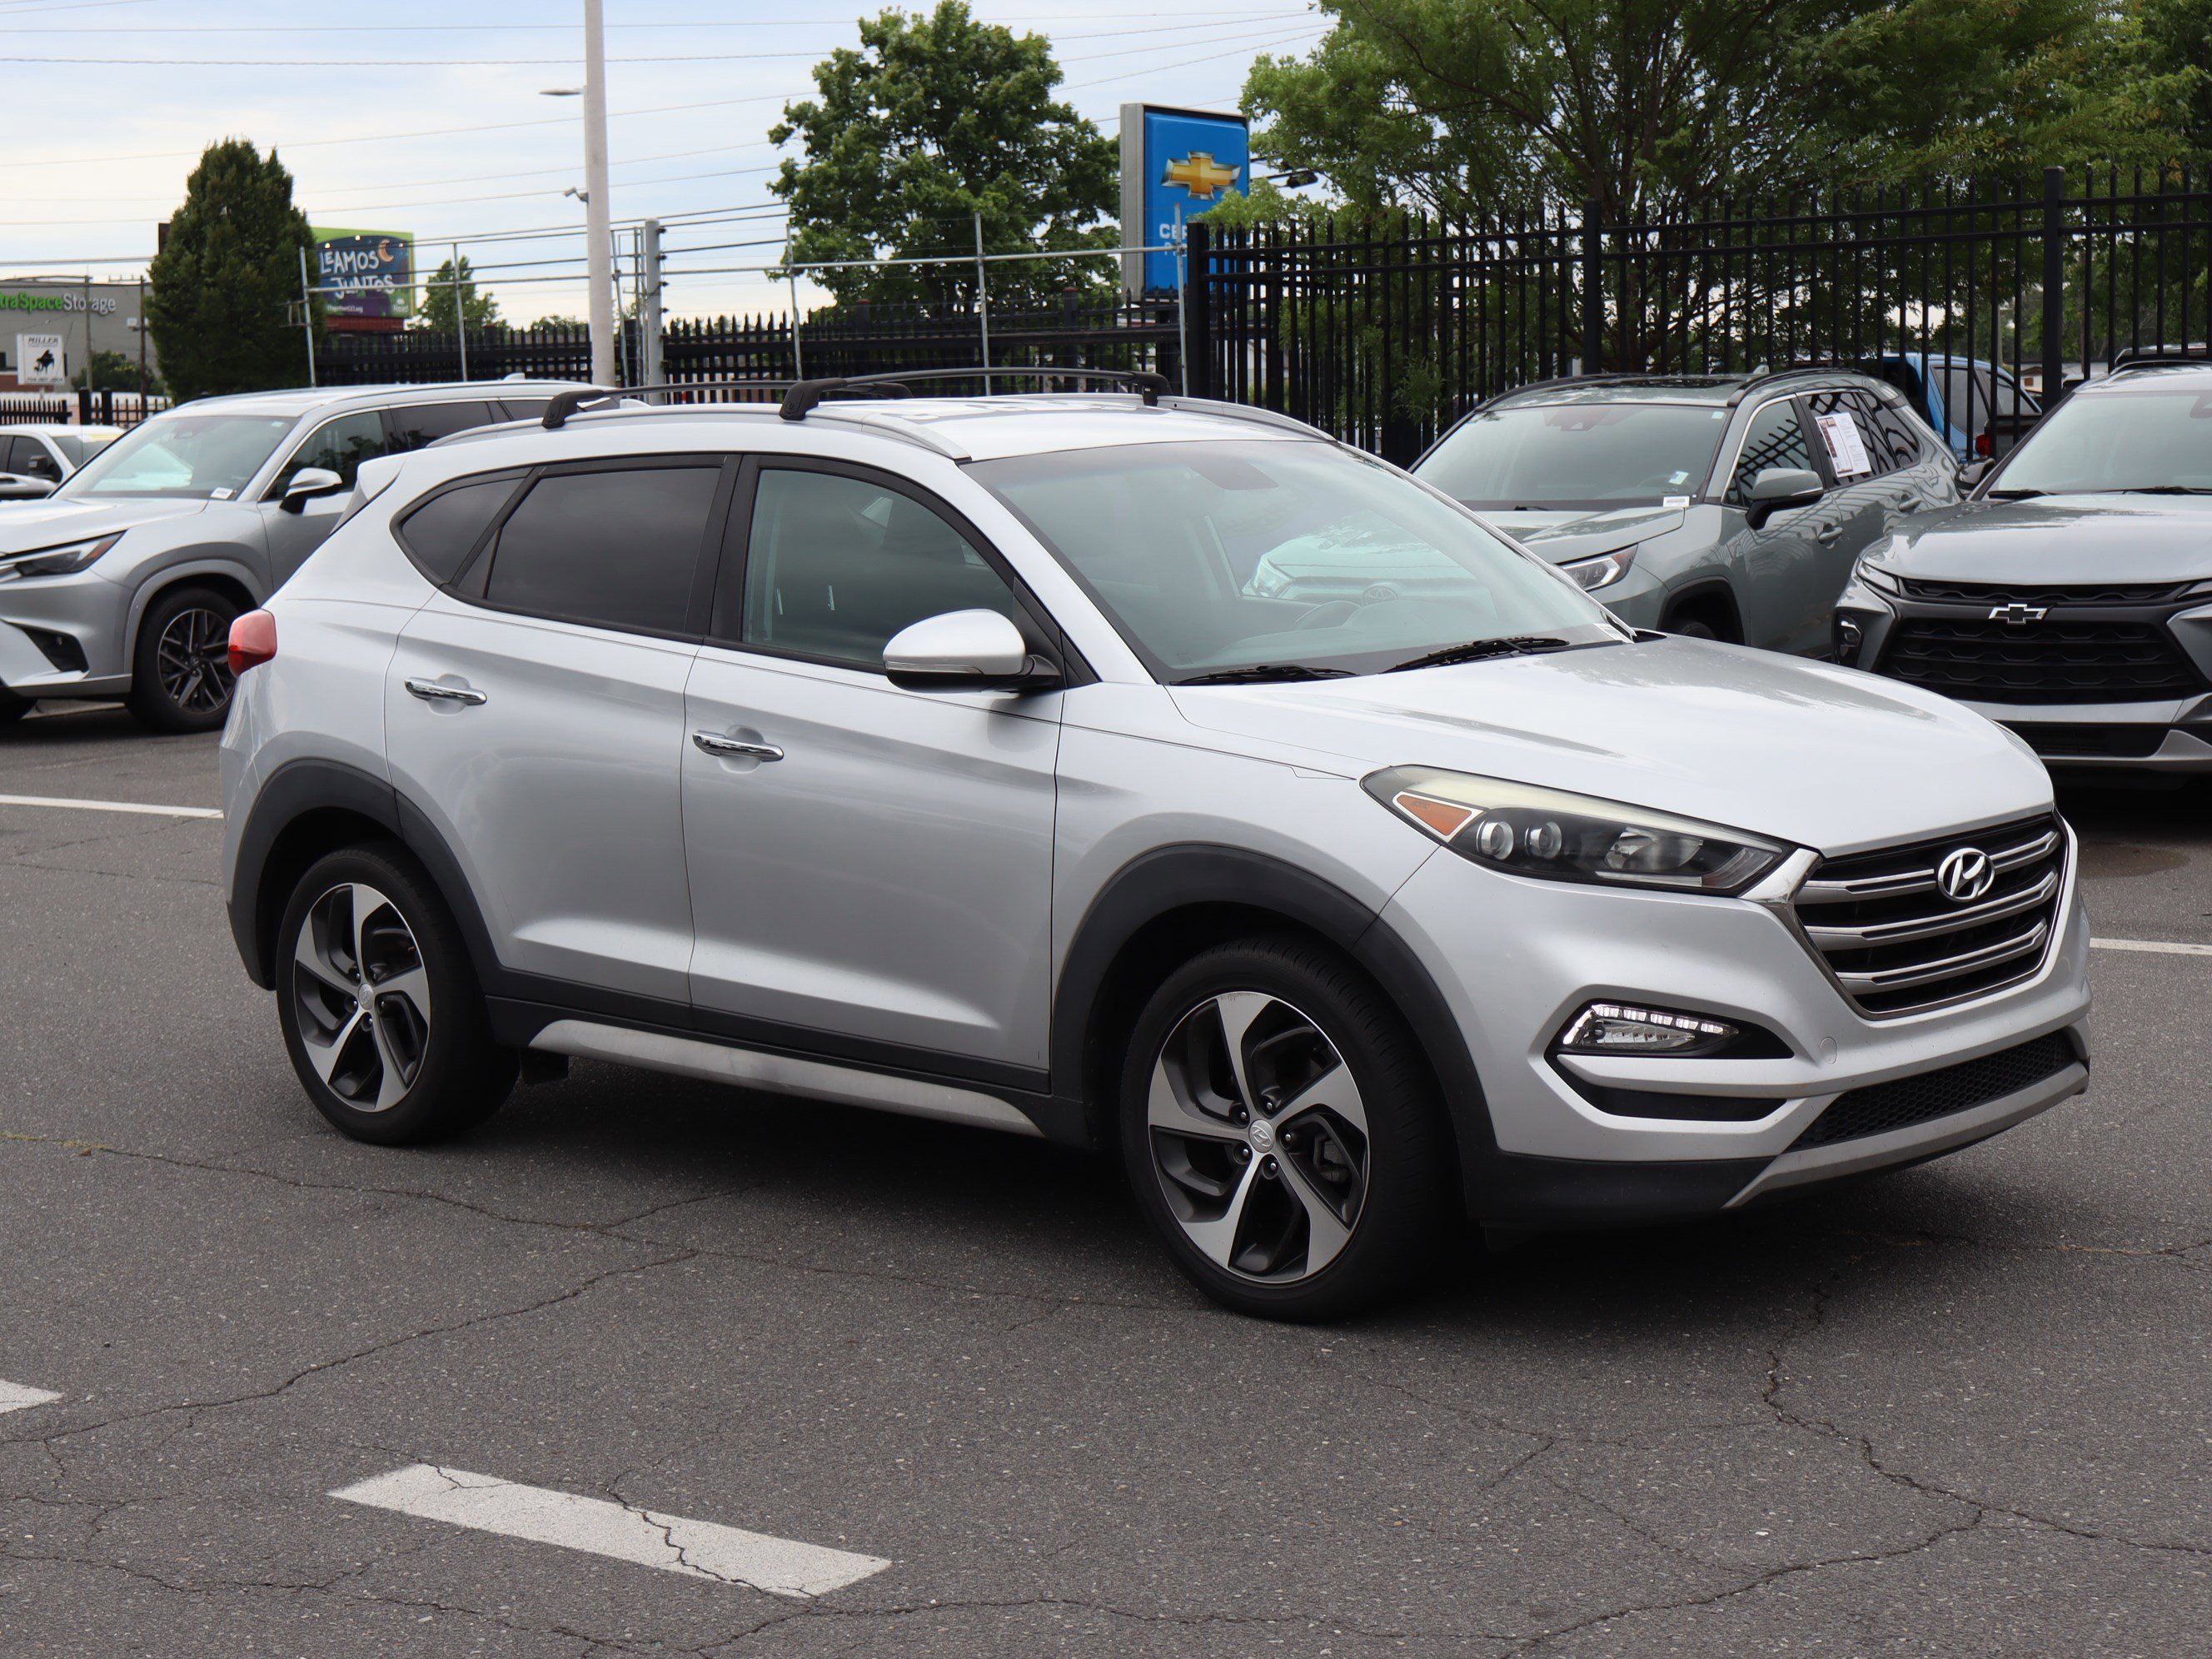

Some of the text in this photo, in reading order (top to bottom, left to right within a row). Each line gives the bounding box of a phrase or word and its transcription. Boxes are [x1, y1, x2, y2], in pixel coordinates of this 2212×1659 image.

[320, 251, 379, 274] LEAMOS
[331, 274, 395, 299] JUNTOS
[0, 292, 116, 315] traSpaceStoage
